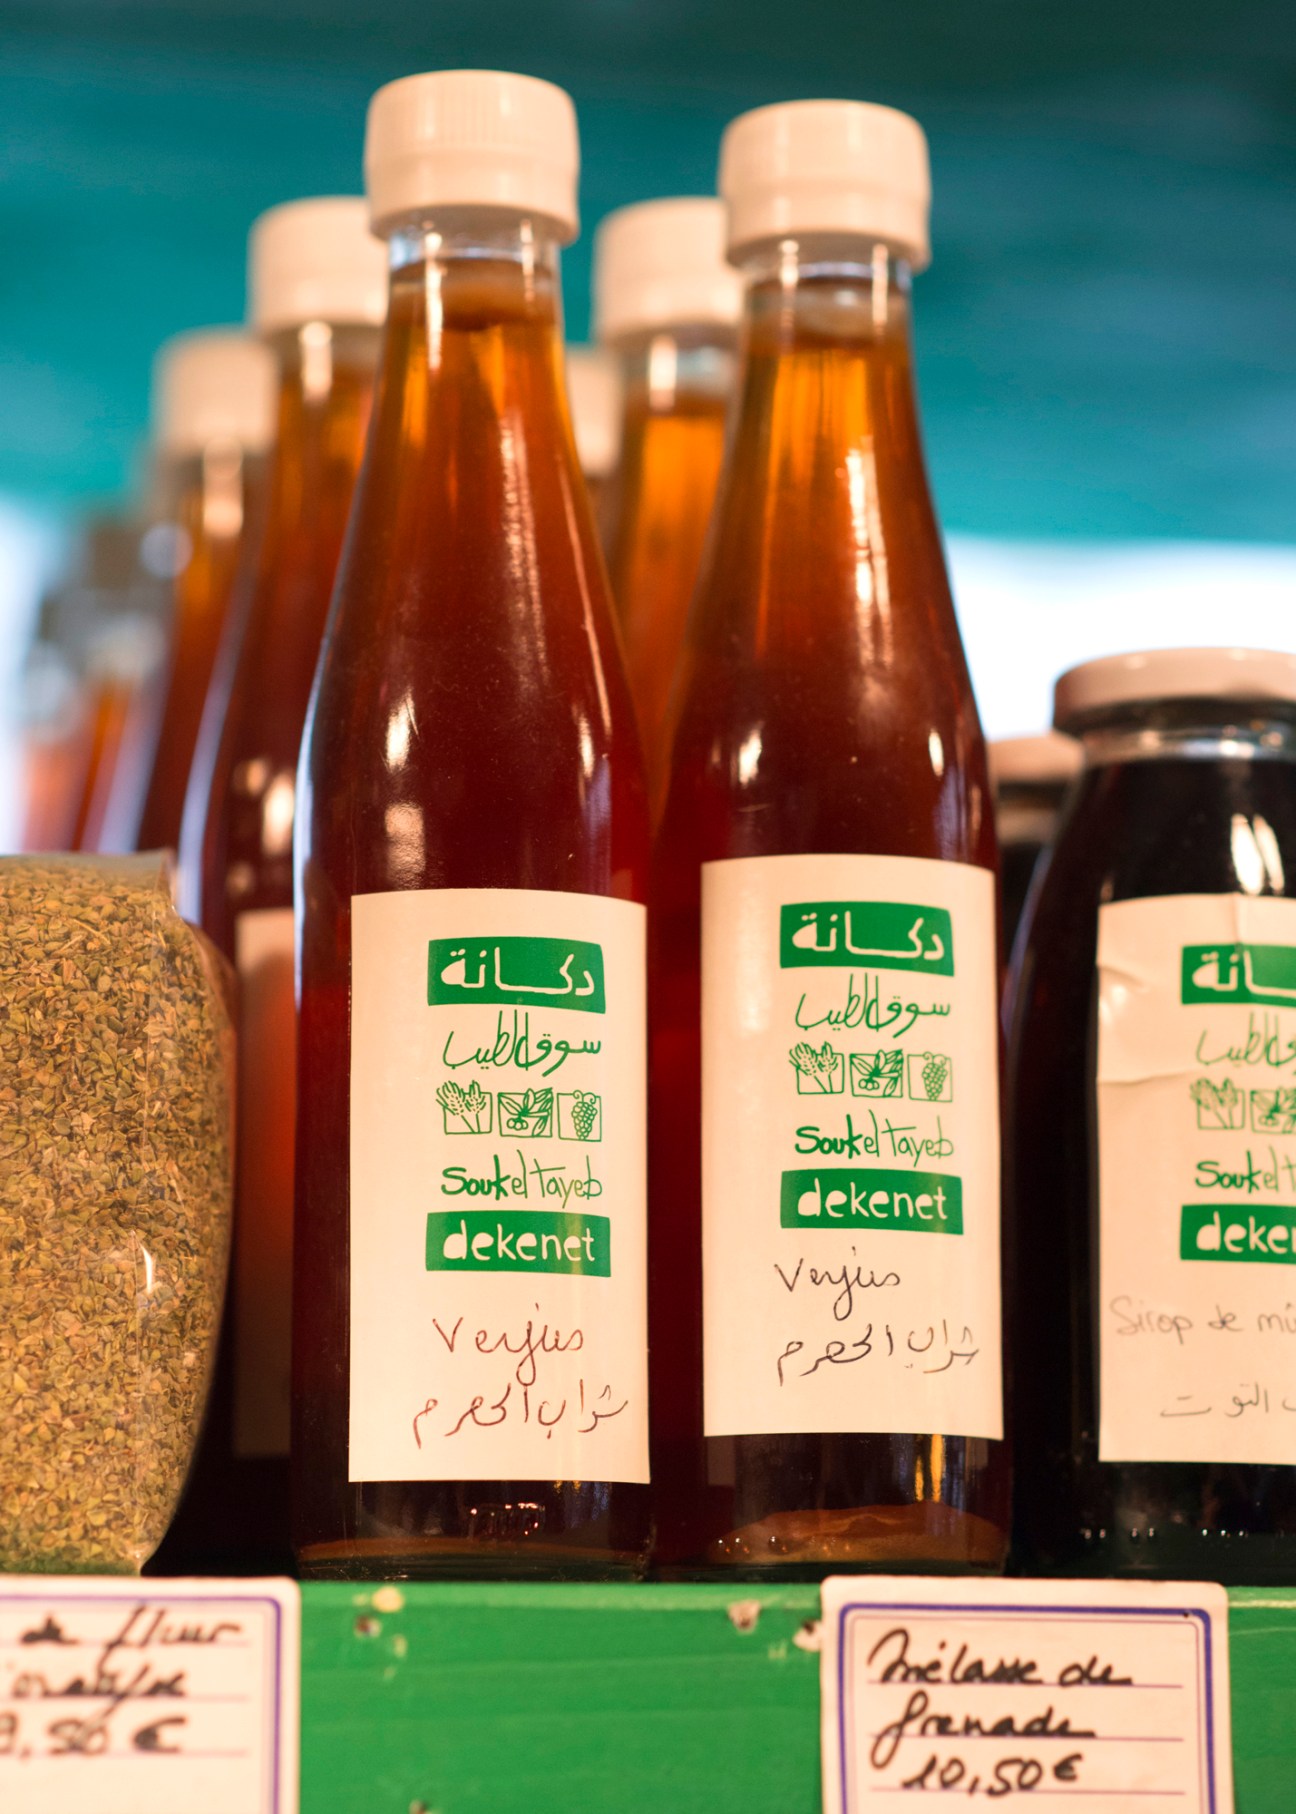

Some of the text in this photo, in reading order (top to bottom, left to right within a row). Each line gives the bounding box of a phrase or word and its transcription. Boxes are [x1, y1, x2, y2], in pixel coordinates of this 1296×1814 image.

[792, 910, 946, 961] دكانة
[440, 946, 596, 997] دكانة
[797, 1177, 948, 1221] dekenet
[442, 1219, 596, 1262] dekenet
[1195, 1210, 1296, 1254] deke
[773, 1245, 901, 1321] Verjus
[431, 1302, 584, 1386] Verjus
[1108, 1294, 1194, 1346] Sirop
[1207, 1303, 1245, 1333] de
[1058, 1655, 1133, 1688] de
